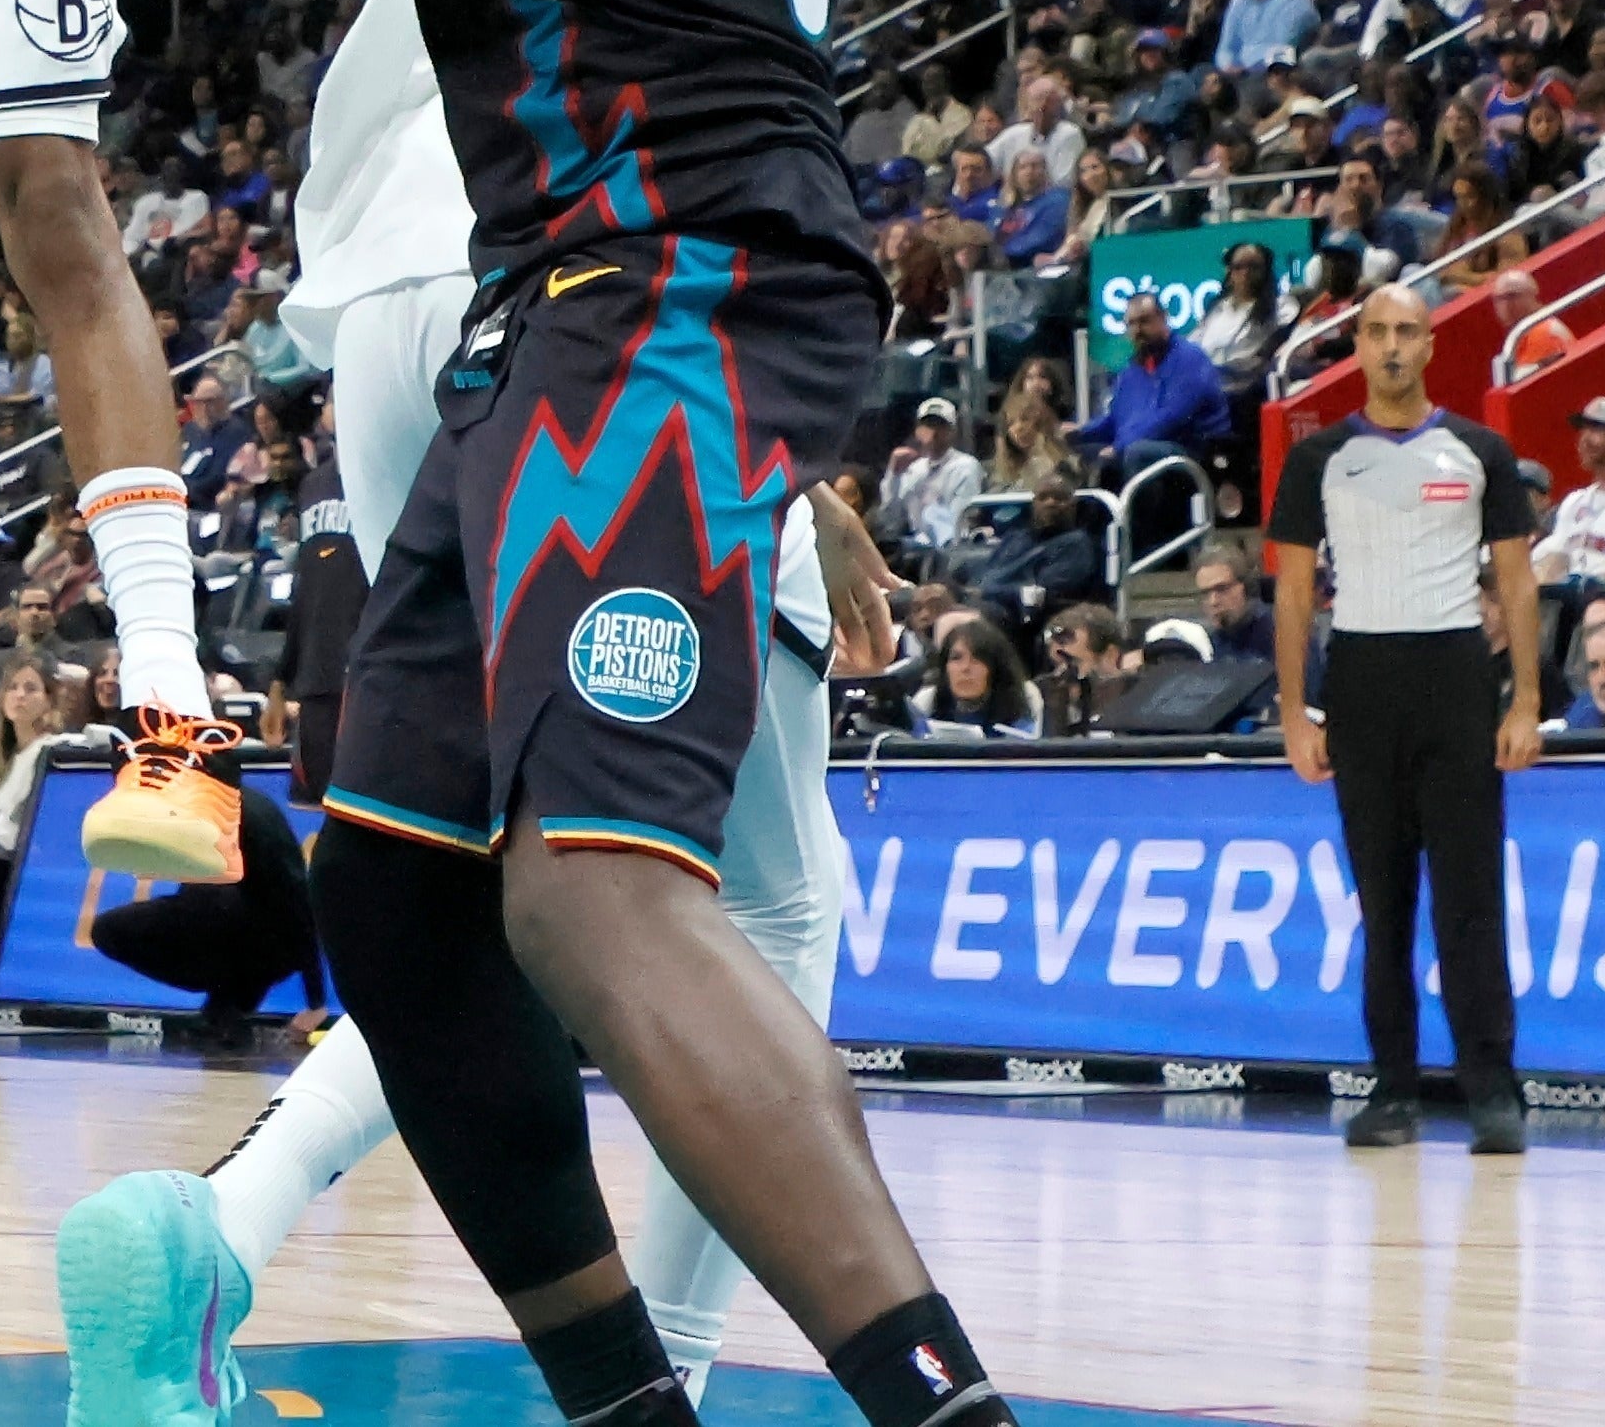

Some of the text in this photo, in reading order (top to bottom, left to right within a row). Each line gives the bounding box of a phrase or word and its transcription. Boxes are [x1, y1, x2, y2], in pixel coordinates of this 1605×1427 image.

[592, 611, 687, 653] DETROIT
[588, 642, 682, 687] PISTONS
[587, 674, 652, 695] BASKETBALL
[651, 680, 679, 699] CLUB
[840, 835, 903, 977] N
[929, 835, 1367, 993] EVERY
[842, 1045, 906, 1072] tockX
[1006, 1056, 1085, 1083] StockX
[1162, 1060, 1246, 1089] StockX
